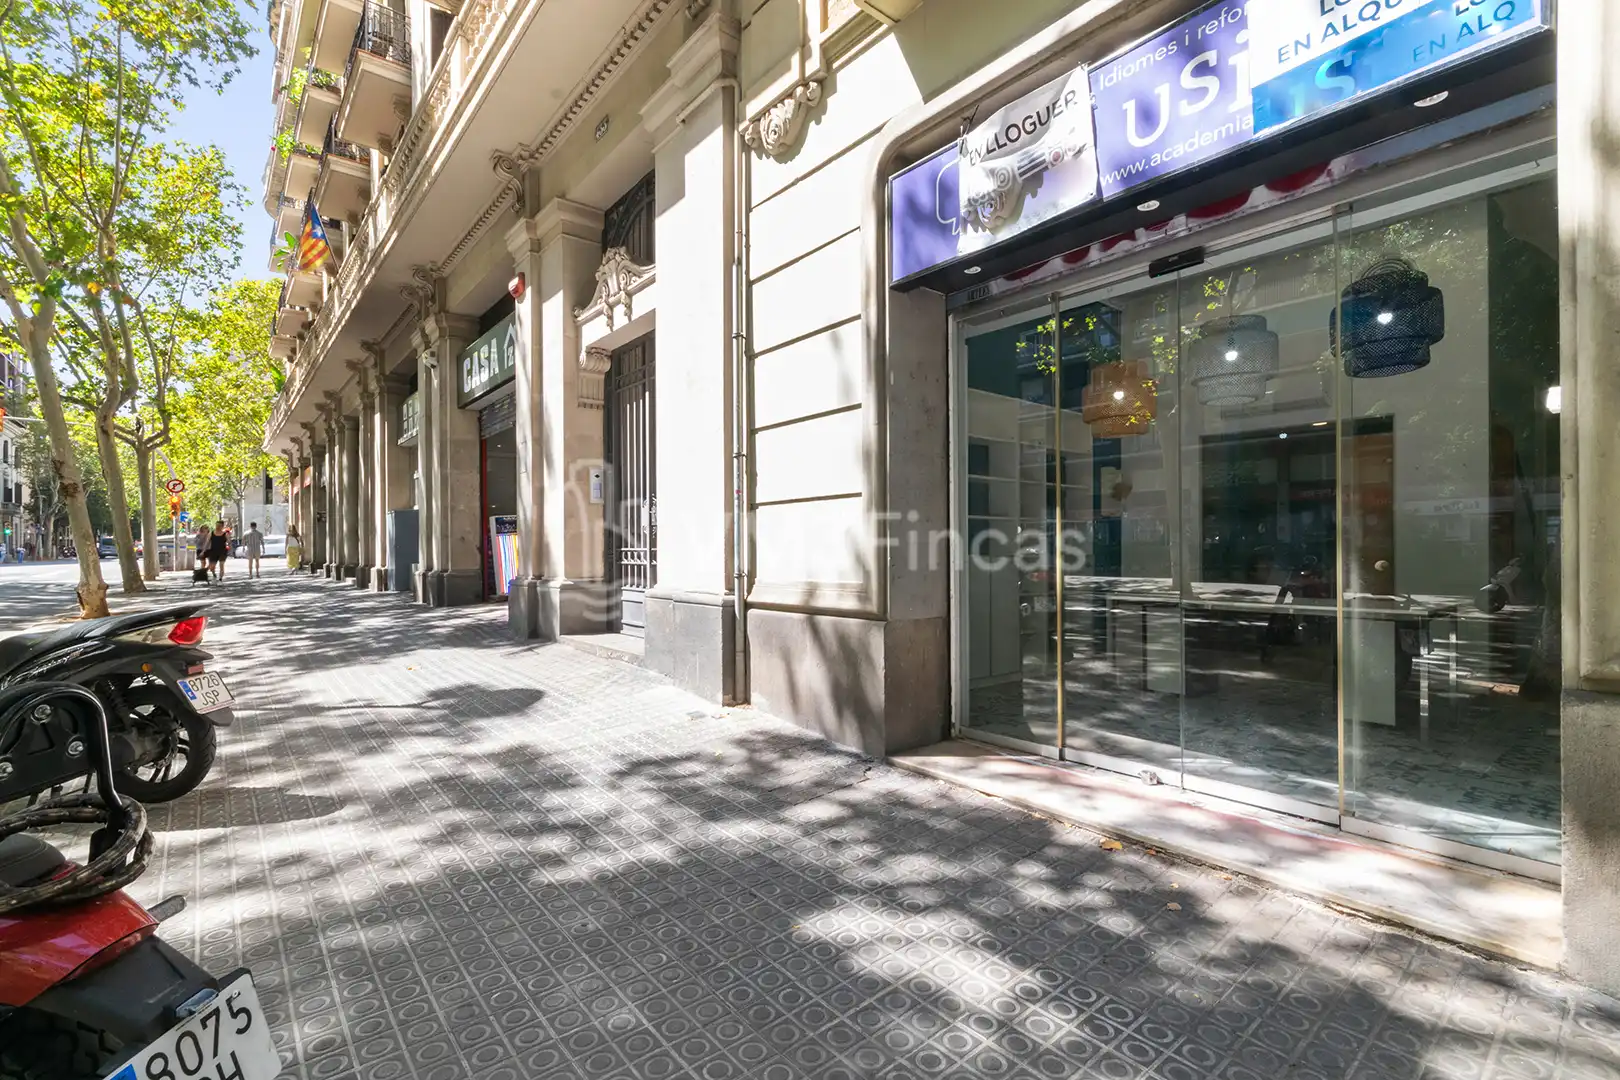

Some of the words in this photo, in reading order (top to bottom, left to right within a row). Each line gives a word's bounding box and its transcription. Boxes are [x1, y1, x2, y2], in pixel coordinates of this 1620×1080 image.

[1100, 40, 1178, 91] Idiomes
[1184, 30, 1189, 46] i
[1278, 33, 1310, 64] EN
[1412, 33, 1446, 62] EN
[985, 89, 1077, 155] LLOGUER
[463, 337, 499, 393] CASA
[188, 673, 220, 692] 8726
[145, 990, 252, 1080] 8075
